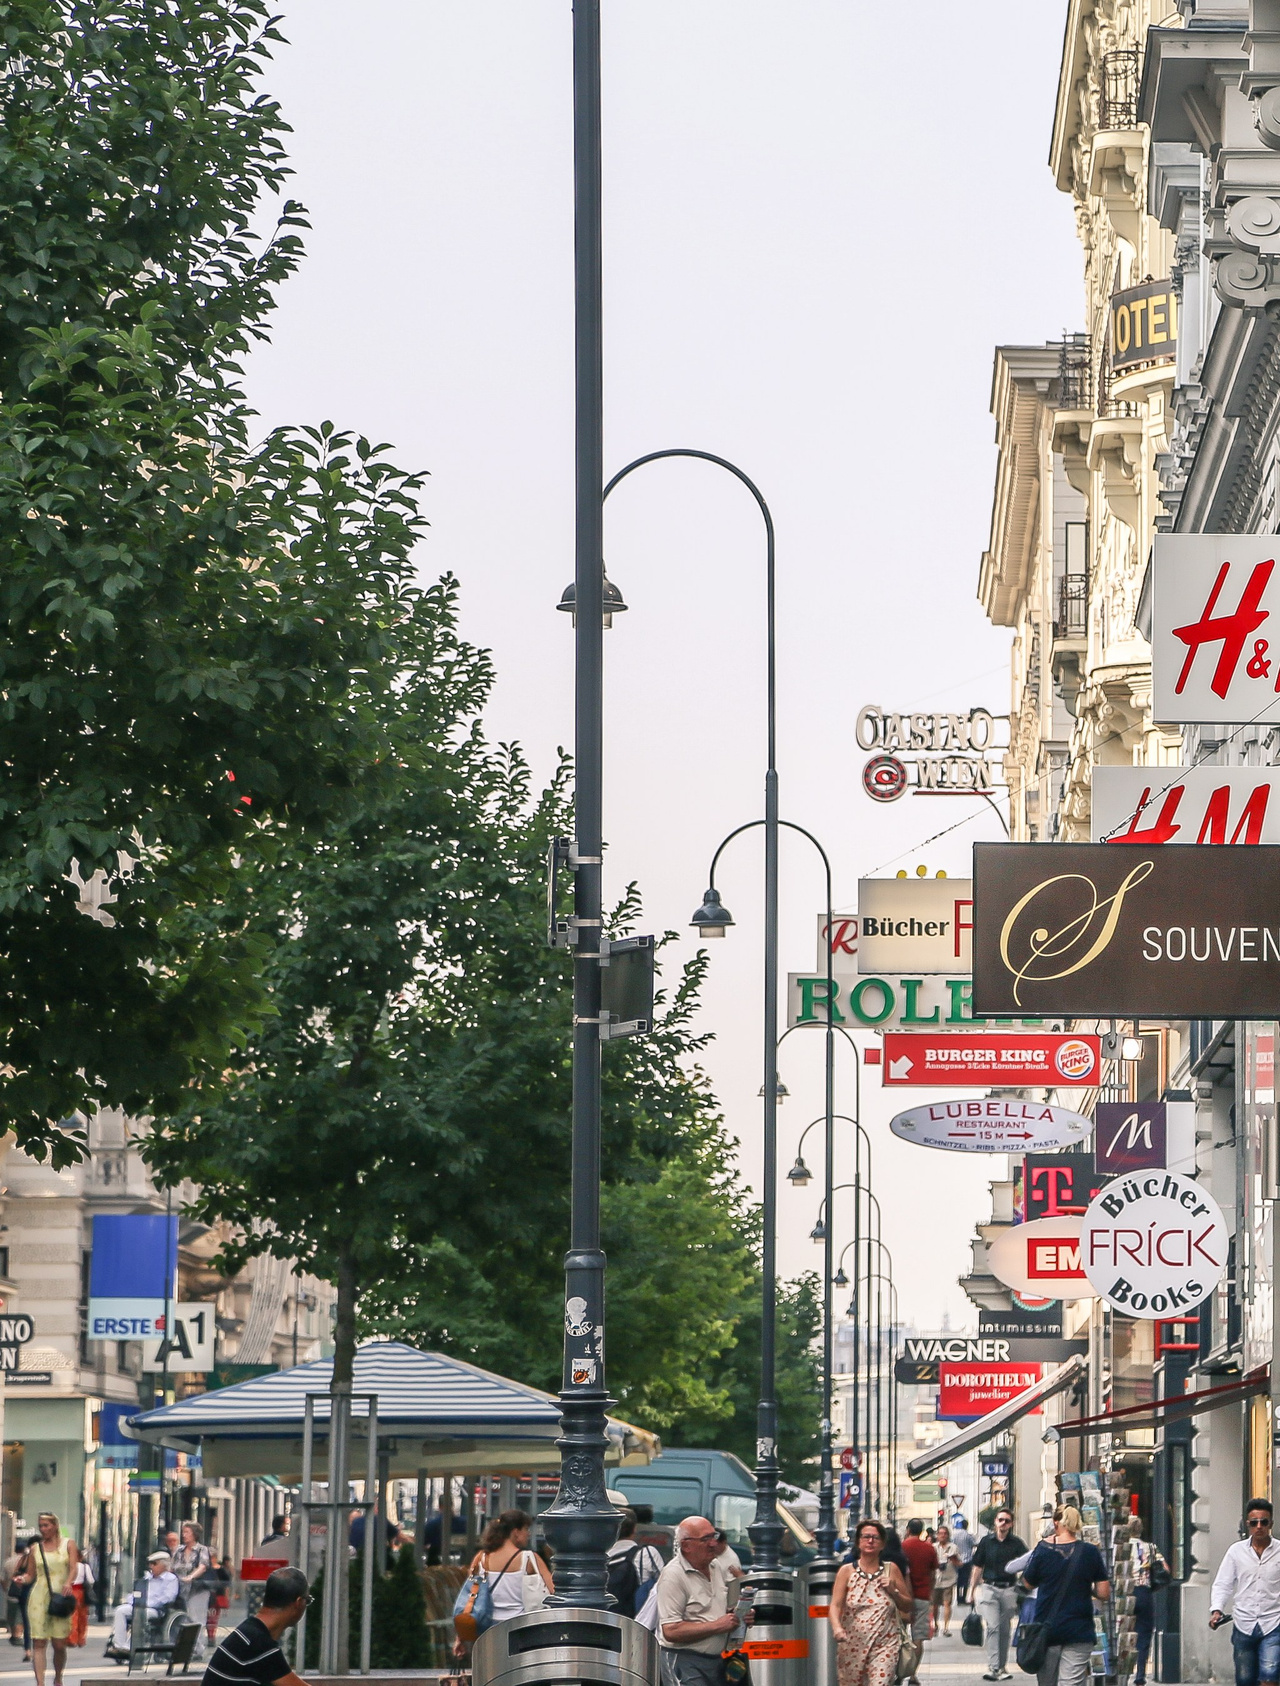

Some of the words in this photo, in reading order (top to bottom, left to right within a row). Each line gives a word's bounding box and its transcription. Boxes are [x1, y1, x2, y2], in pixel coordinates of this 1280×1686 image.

[1112, 292, 1178, 356] OTEL
[856, 705, 994, 750] CASINO
[916, 758, 993, 788] WIEN
[862, 917, 950, 937] Bücher
[796, 978, 1043, 1024] ROLE
[925, 1049, 997, 1061] BURGER
[1000, 1049, 1047, 1062] KING
[1060, 1048, 1089, 1061] BURGER
[1062, 1055, 1090, 1070] KING
[929, 1102, 1055, 1122] LUBELLA
[956, 1120, 1027, 1129] RESTAURANT
[979, 1131, 993, 1139] 15
[1100, 1175, 1210, 1219] Bücher
[1108, 1277, 1203, 1312] Books
[94, 1318, 152, 1335] ERSTE
[979, 1322, 1062, 1334] intimissim
[155, 1311, 206, 1363] A1
[906, 1339, 1011, 1363] WAGNER
[944, 1373, 1036, 1388] DOROTHEUM
[969, 1388, 1012, 1403] juwelier
